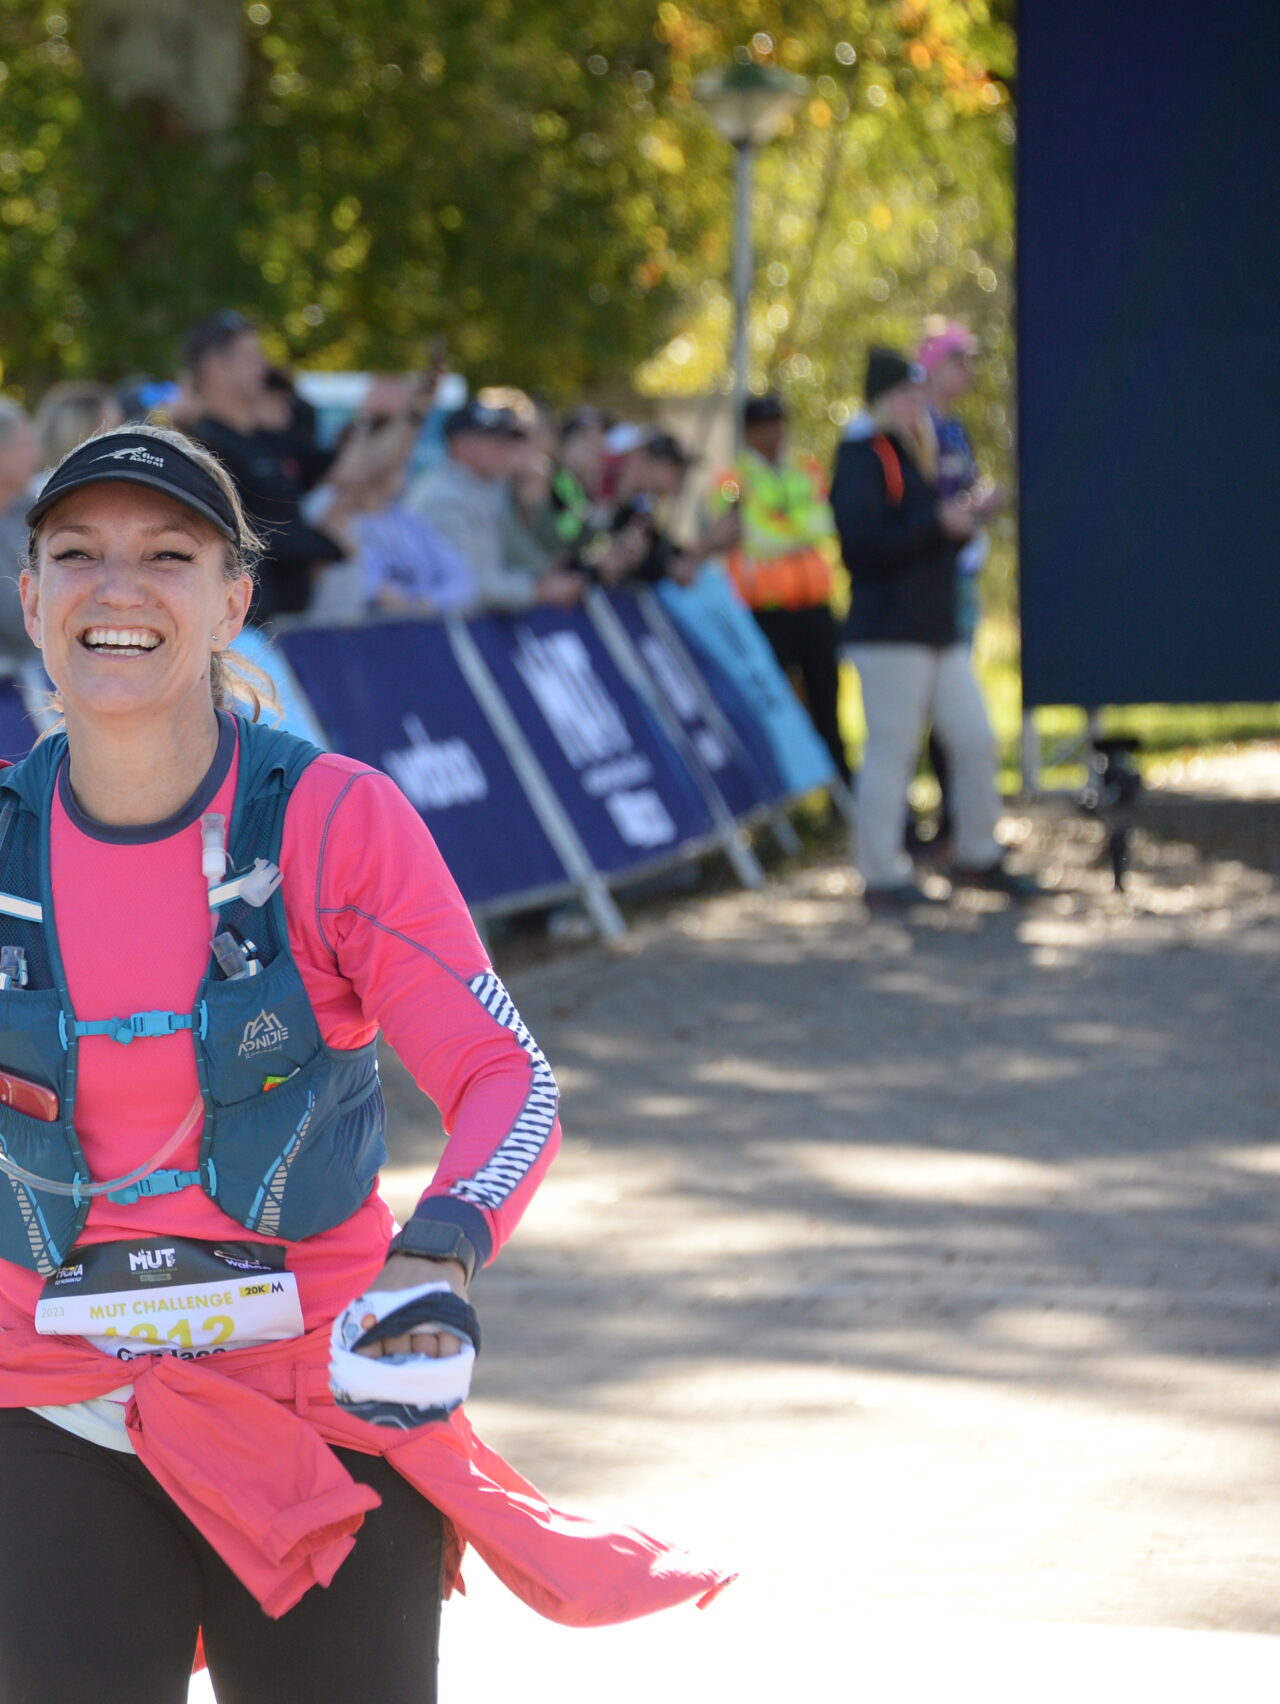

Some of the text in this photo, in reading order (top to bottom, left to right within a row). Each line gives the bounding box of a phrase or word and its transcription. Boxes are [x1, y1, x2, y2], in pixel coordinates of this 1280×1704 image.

[128, 1247, 176, 1272] MUT
[245, 1285, 265, 1295] 20K
[89, 1291, 233, 1320] MUT CHALLENGE
